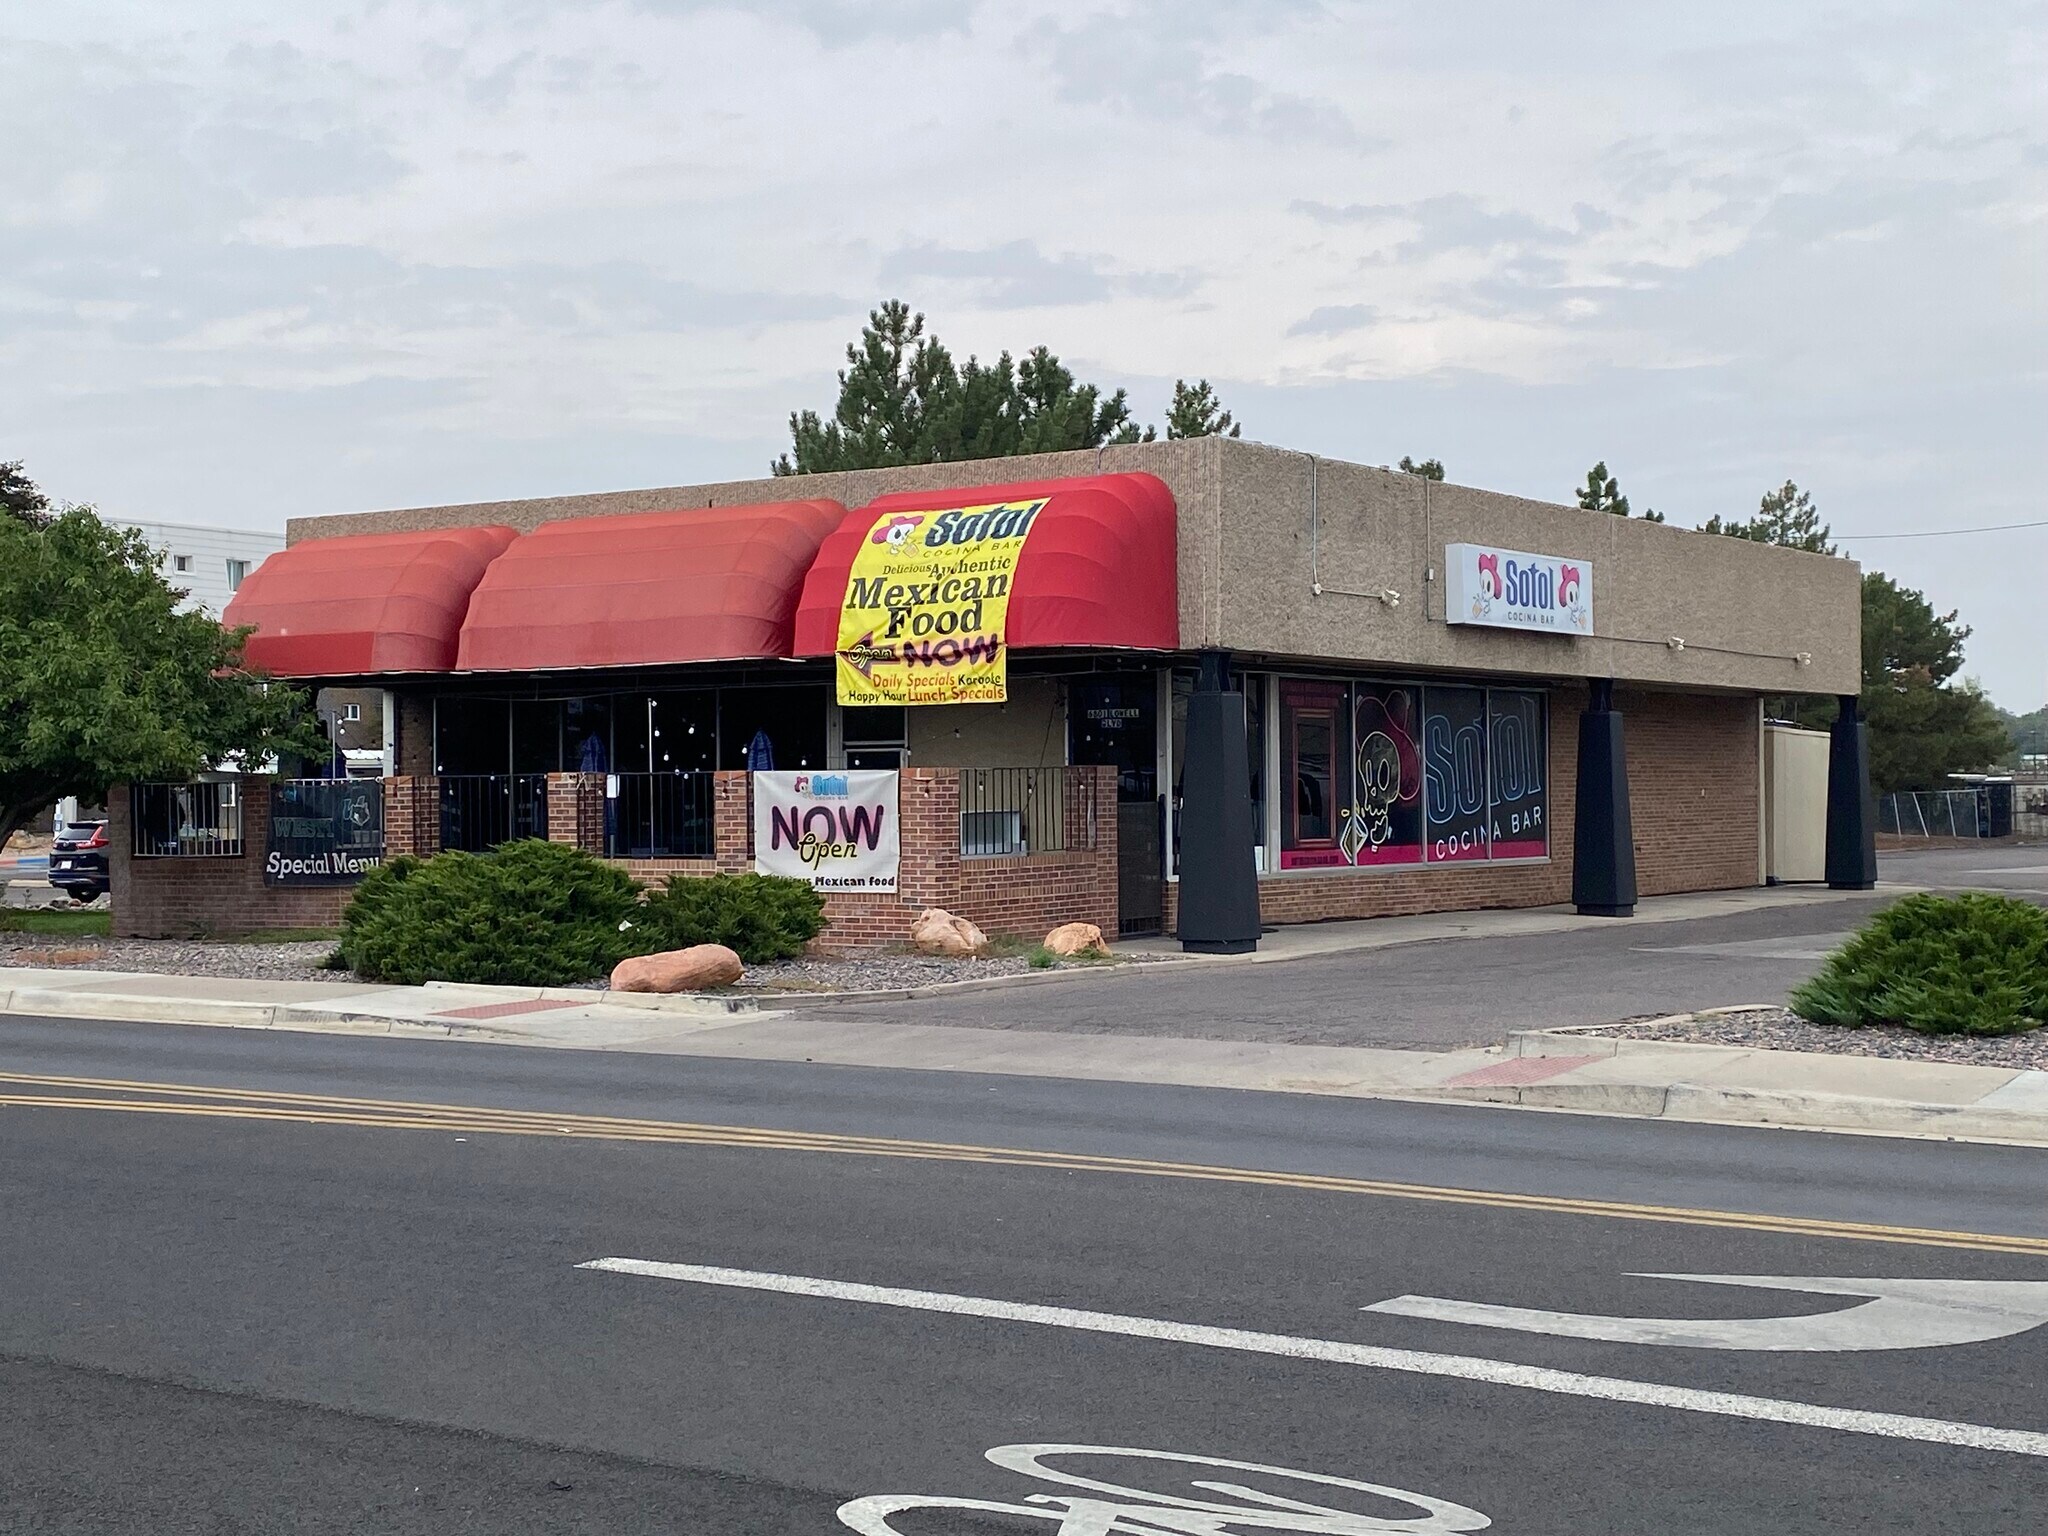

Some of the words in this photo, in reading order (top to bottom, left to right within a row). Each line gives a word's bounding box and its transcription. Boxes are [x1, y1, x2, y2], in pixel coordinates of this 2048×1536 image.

[924, 503, 1043, 547] Sotol
[923, 545, 981, 558] COCINA
[991, 540, 1022, 551] BAR
[883, 564, 931, 575] Delicious
[928, 556, 1012, 578] Authentic
[1505, 559, 1555, 610] Sotol
[846, 573, 1008, 609] Mexican
[884, 601, 983, 639] Food
[1507, 611, 1537, 623] COCINA
[1540, 614, 1555, 625] BAR
[850, 645, 893, 668] Open
[902, 633, 999, 668] NOW
[849, 690, 880, 703] Happy
[883, 689, 906, 701] Hour
[908, 688, 946, 702] Lunch
[951, 685, 1005, 703] Specials
[873, 675, 902, 688] Daily
[907, 673, 955, 690] Specials
[958, 673, 1003, 687] Karaoke
[1425, 695, 1542, 824] Sotol
[772, 805, 884, 850] NOW
[1435, 822, 1502, 860] COCINA
[1510, 805, 1543, 834] BAR
[266, 851, 331, 879] Special
[798, 833, 858, 871] Open
[815, 876, 866, 887] Mexican
